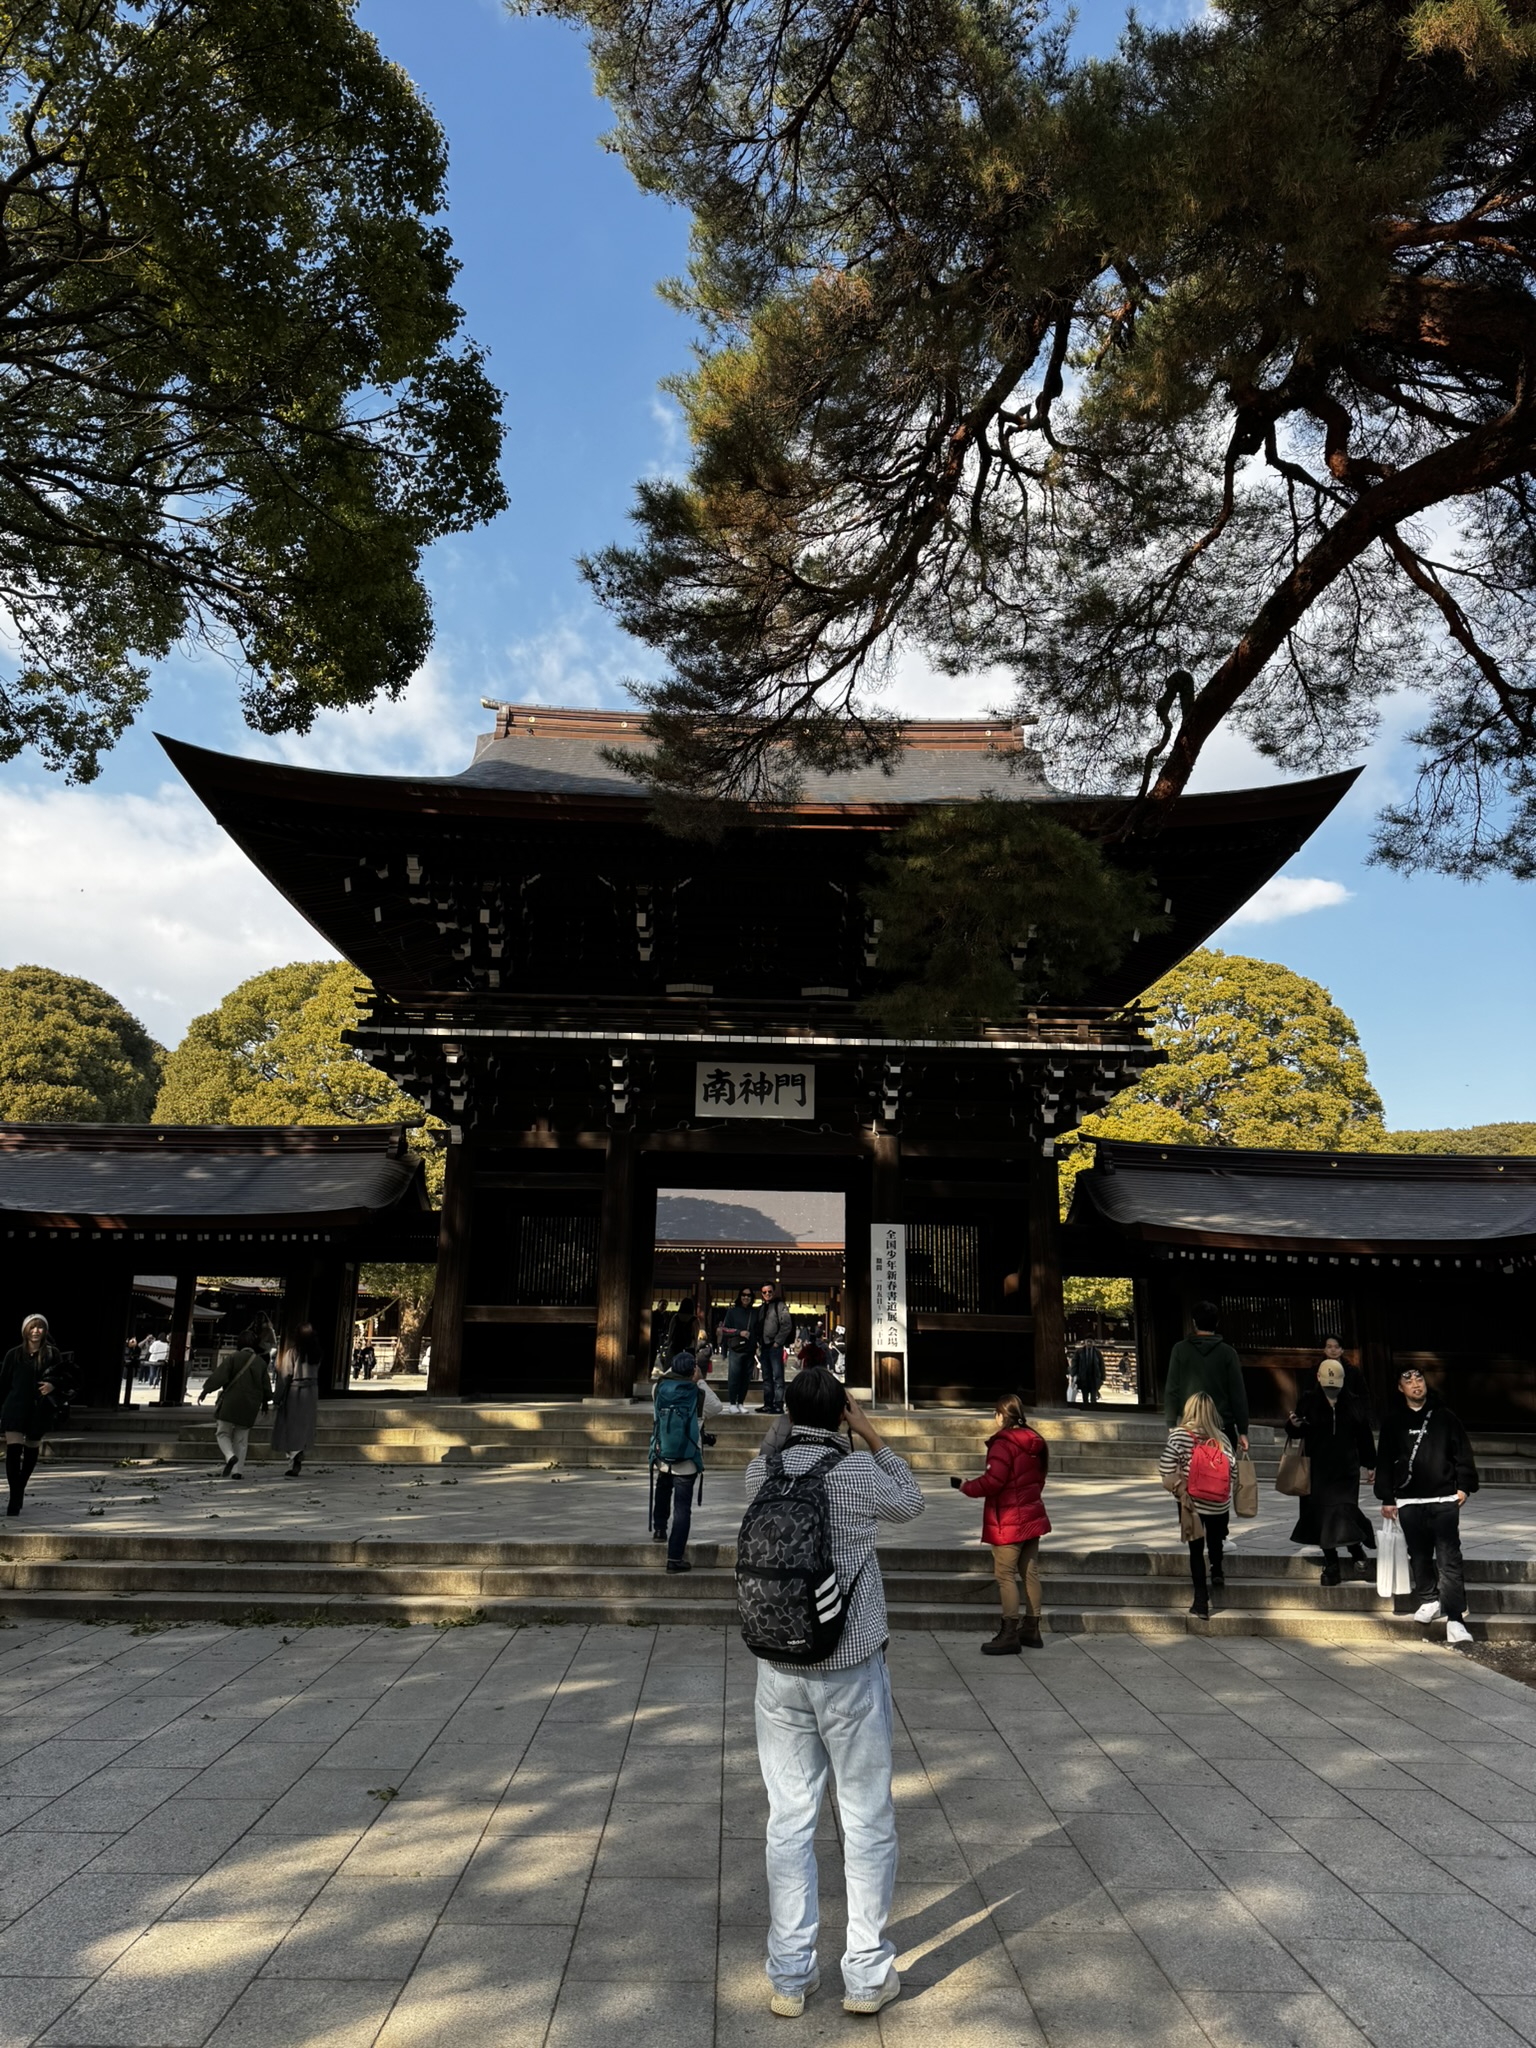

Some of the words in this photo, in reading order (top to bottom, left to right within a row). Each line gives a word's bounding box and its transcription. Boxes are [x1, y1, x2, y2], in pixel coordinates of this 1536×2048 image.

[702, 1067, 807, 1107] 南神門
[885, 1229, 898, 1322] 全国少年新春書道展
[887, 1326, 898, 1348] 会場
